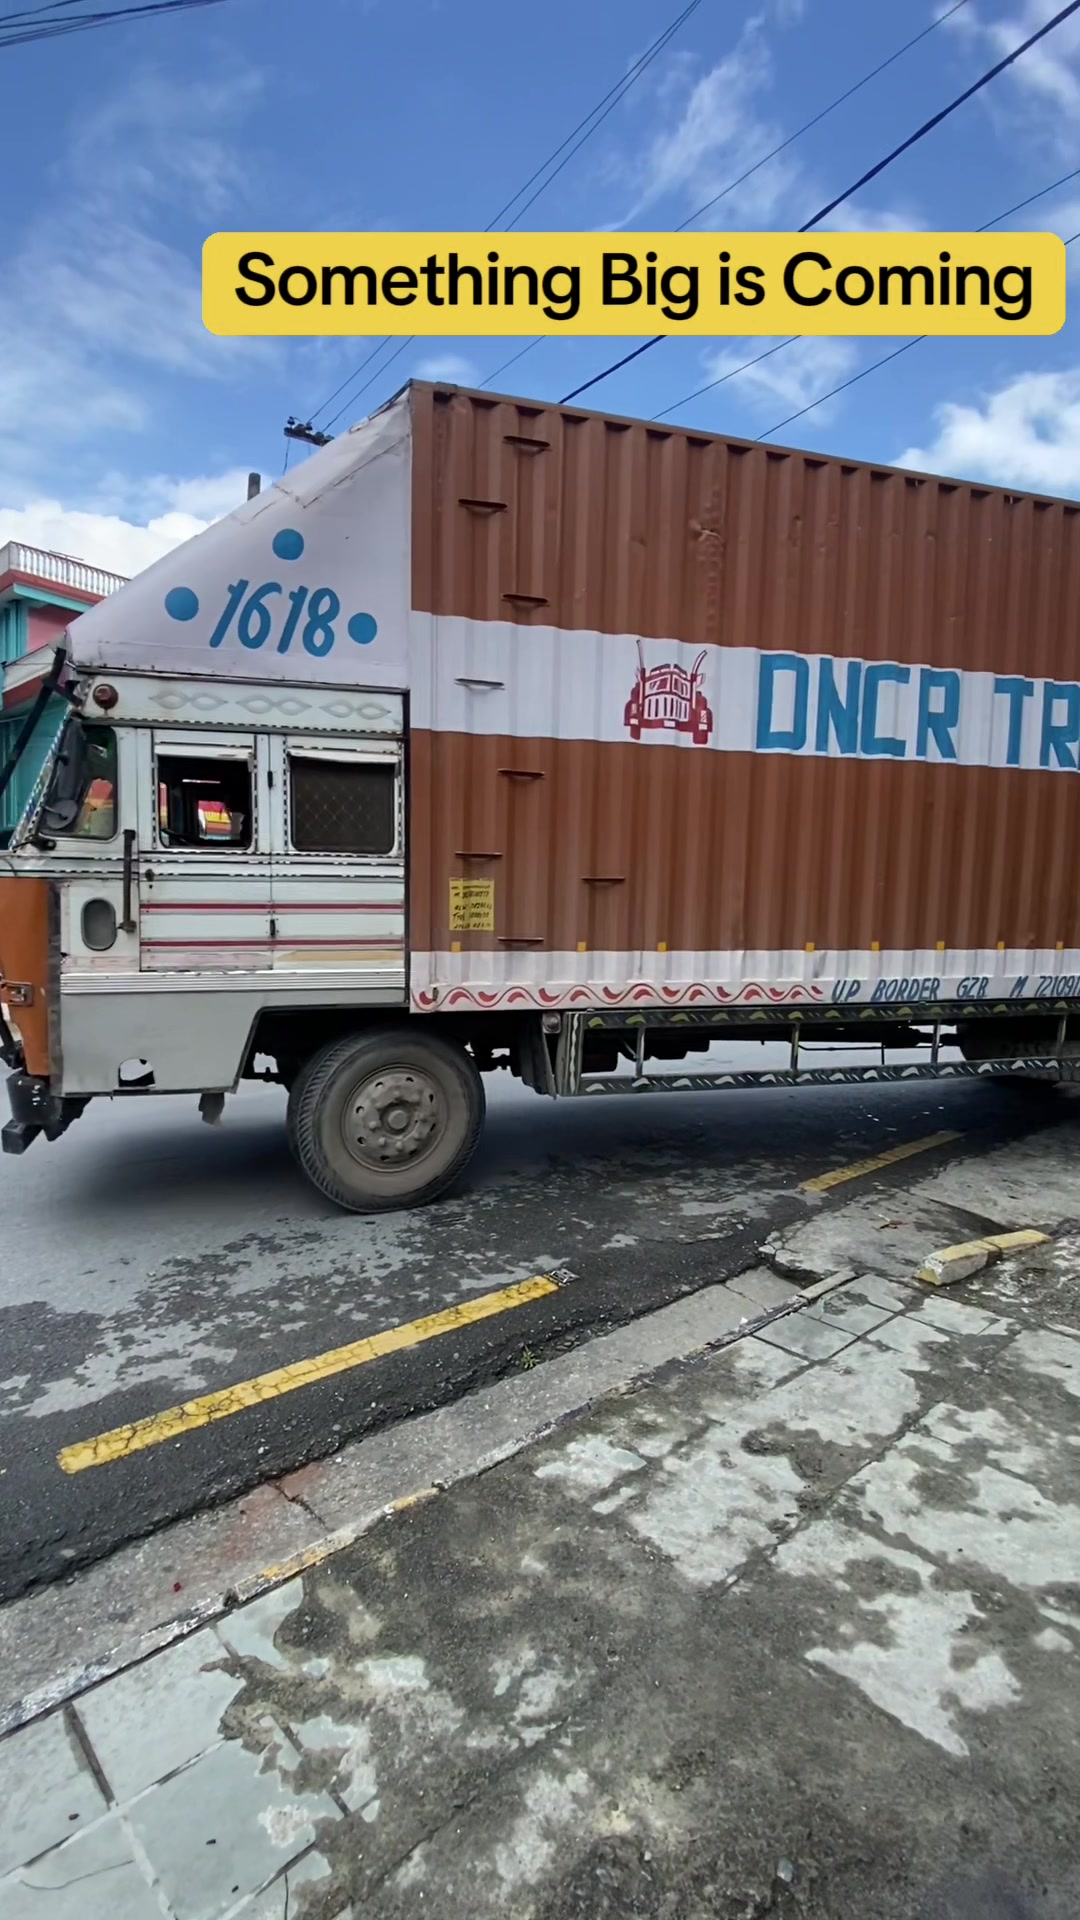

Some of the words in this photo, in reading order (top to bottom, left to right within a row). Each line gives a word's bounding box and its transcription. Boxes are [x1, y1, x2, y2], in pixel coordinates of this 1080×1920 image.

[210, 579, 340, 657] 1618
[756, 653, 960, 760] DNCR
[995, 676, 1080, 770] TR
[871, 978, 941, 1001] BORDER
